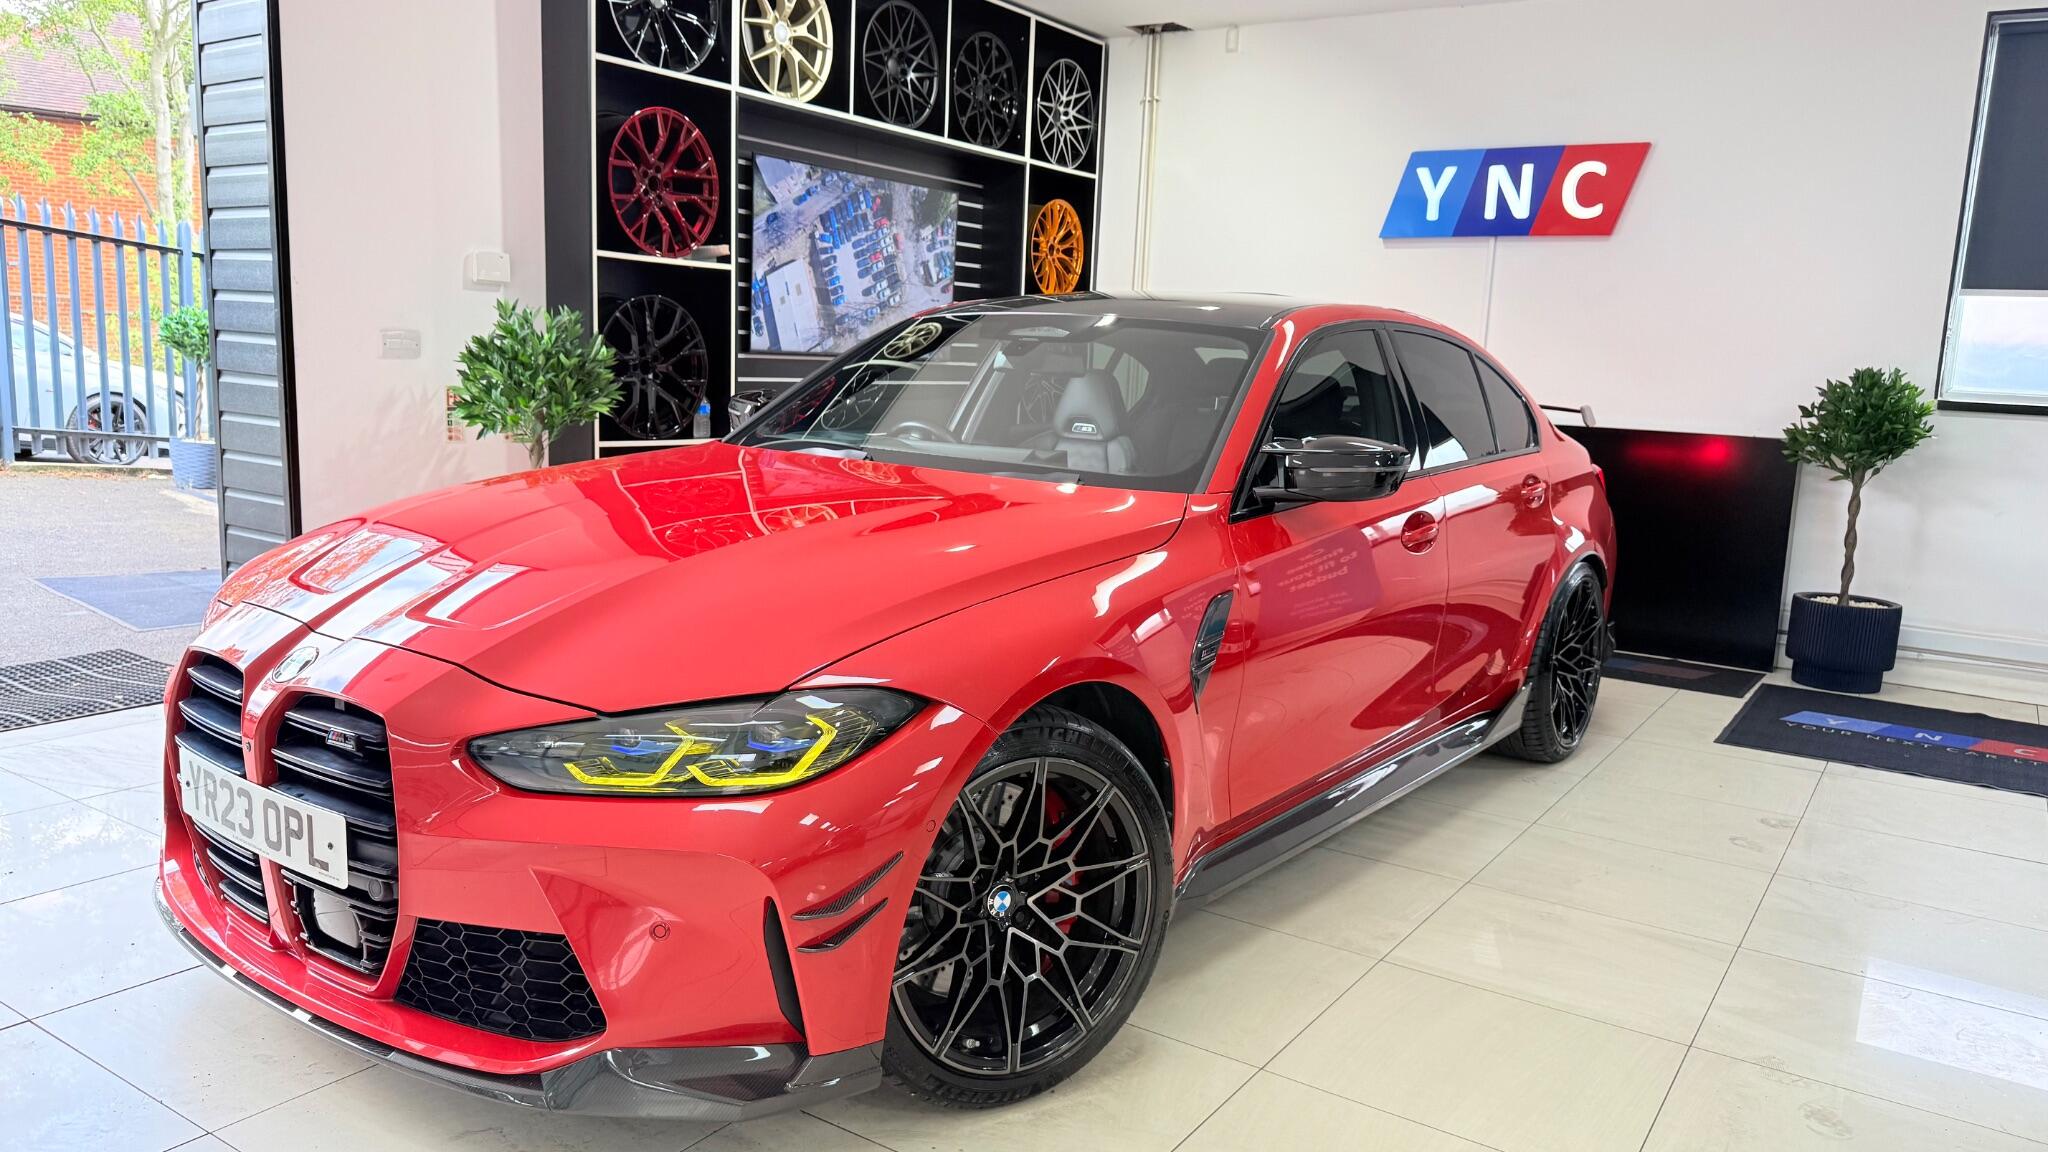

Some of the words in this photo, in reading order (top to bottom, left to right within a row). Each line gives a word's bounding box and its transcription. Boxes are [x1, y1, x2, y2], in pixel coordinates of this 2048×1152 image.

[1416, 160, 1607, 221] YNC
[1785, 721, 1852, 736] YOUR
[1866, 734, 1933, 748] NEXT
[1946, 747, 1998, 759] CAR
[189, 760, 255, 840] YR23
[263, 798, 330, 873] OPL
